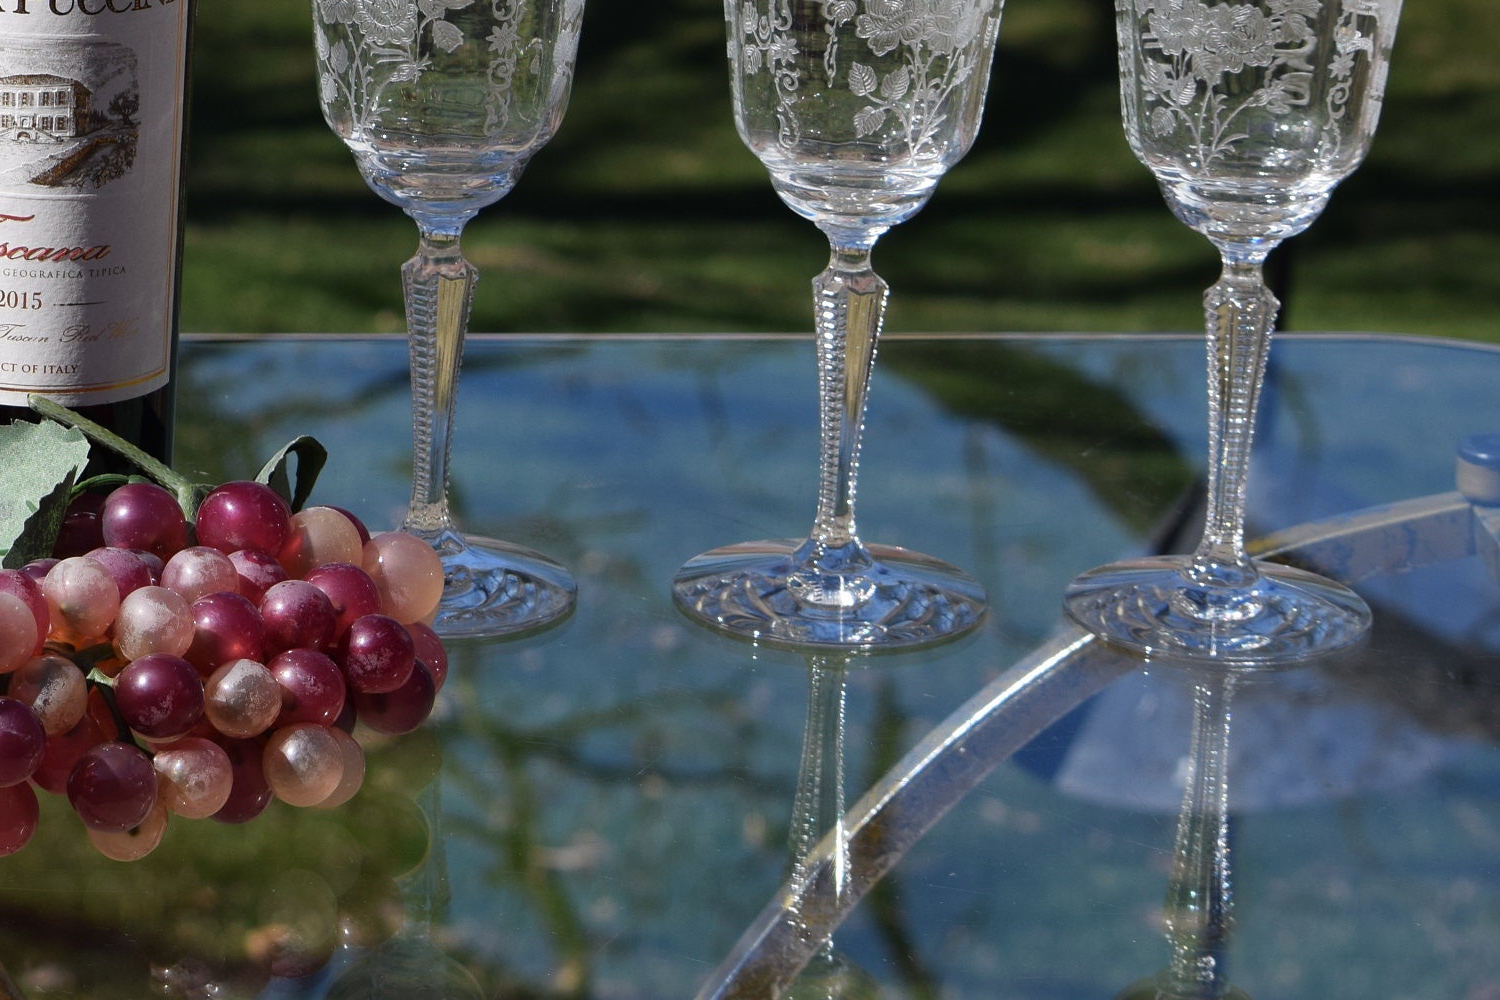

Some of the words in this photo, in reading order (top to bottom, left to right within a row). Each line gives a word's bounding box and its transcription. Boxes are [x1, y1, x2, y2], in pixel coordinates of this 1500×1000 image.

[3, 268, 83, 279] GEOGRAFICA
[89, 266, 127, 277] TIPICA
[60, 324, 102, 343] Red
[22, 364, 39, 374] OF
[43, 364, 79, 374] ITALY
